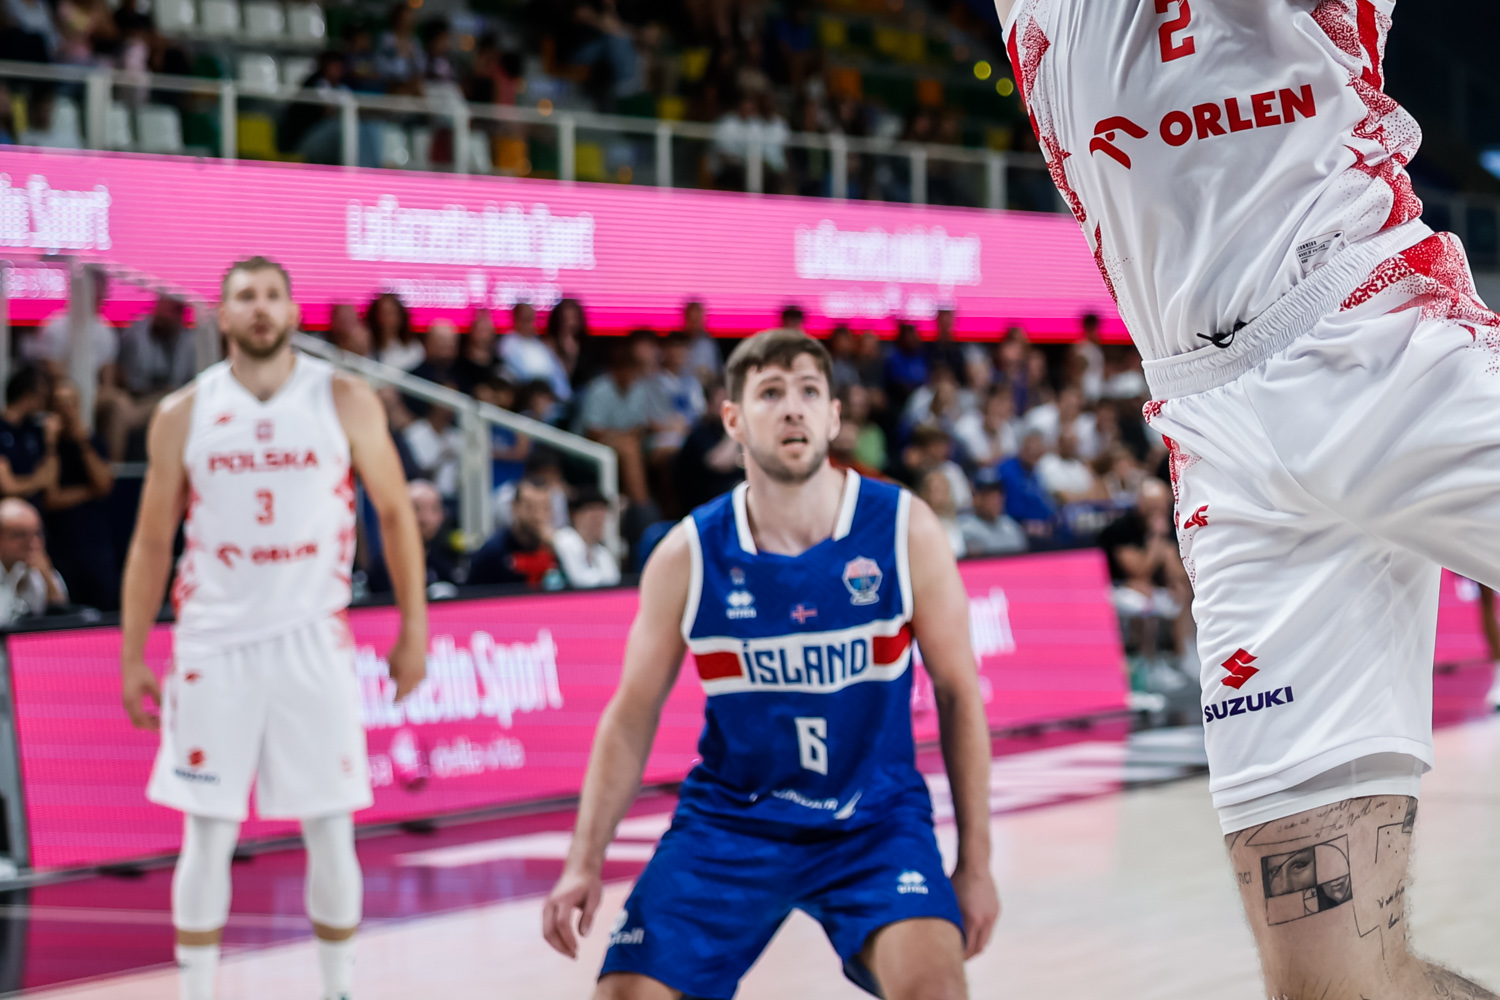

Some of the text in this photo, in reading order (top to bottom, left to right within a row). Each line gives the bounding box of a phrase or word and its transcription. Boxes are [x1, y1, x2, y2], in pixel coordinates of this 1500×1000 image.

[1159, 84, 1317, 147] ORLEN
[208, 447, 320, 475] POLSKA
[254, 489, 275, 526] 3
[1204, 685, 1294, 723] SUZUKI
[794, 717, 828, 776] 6
